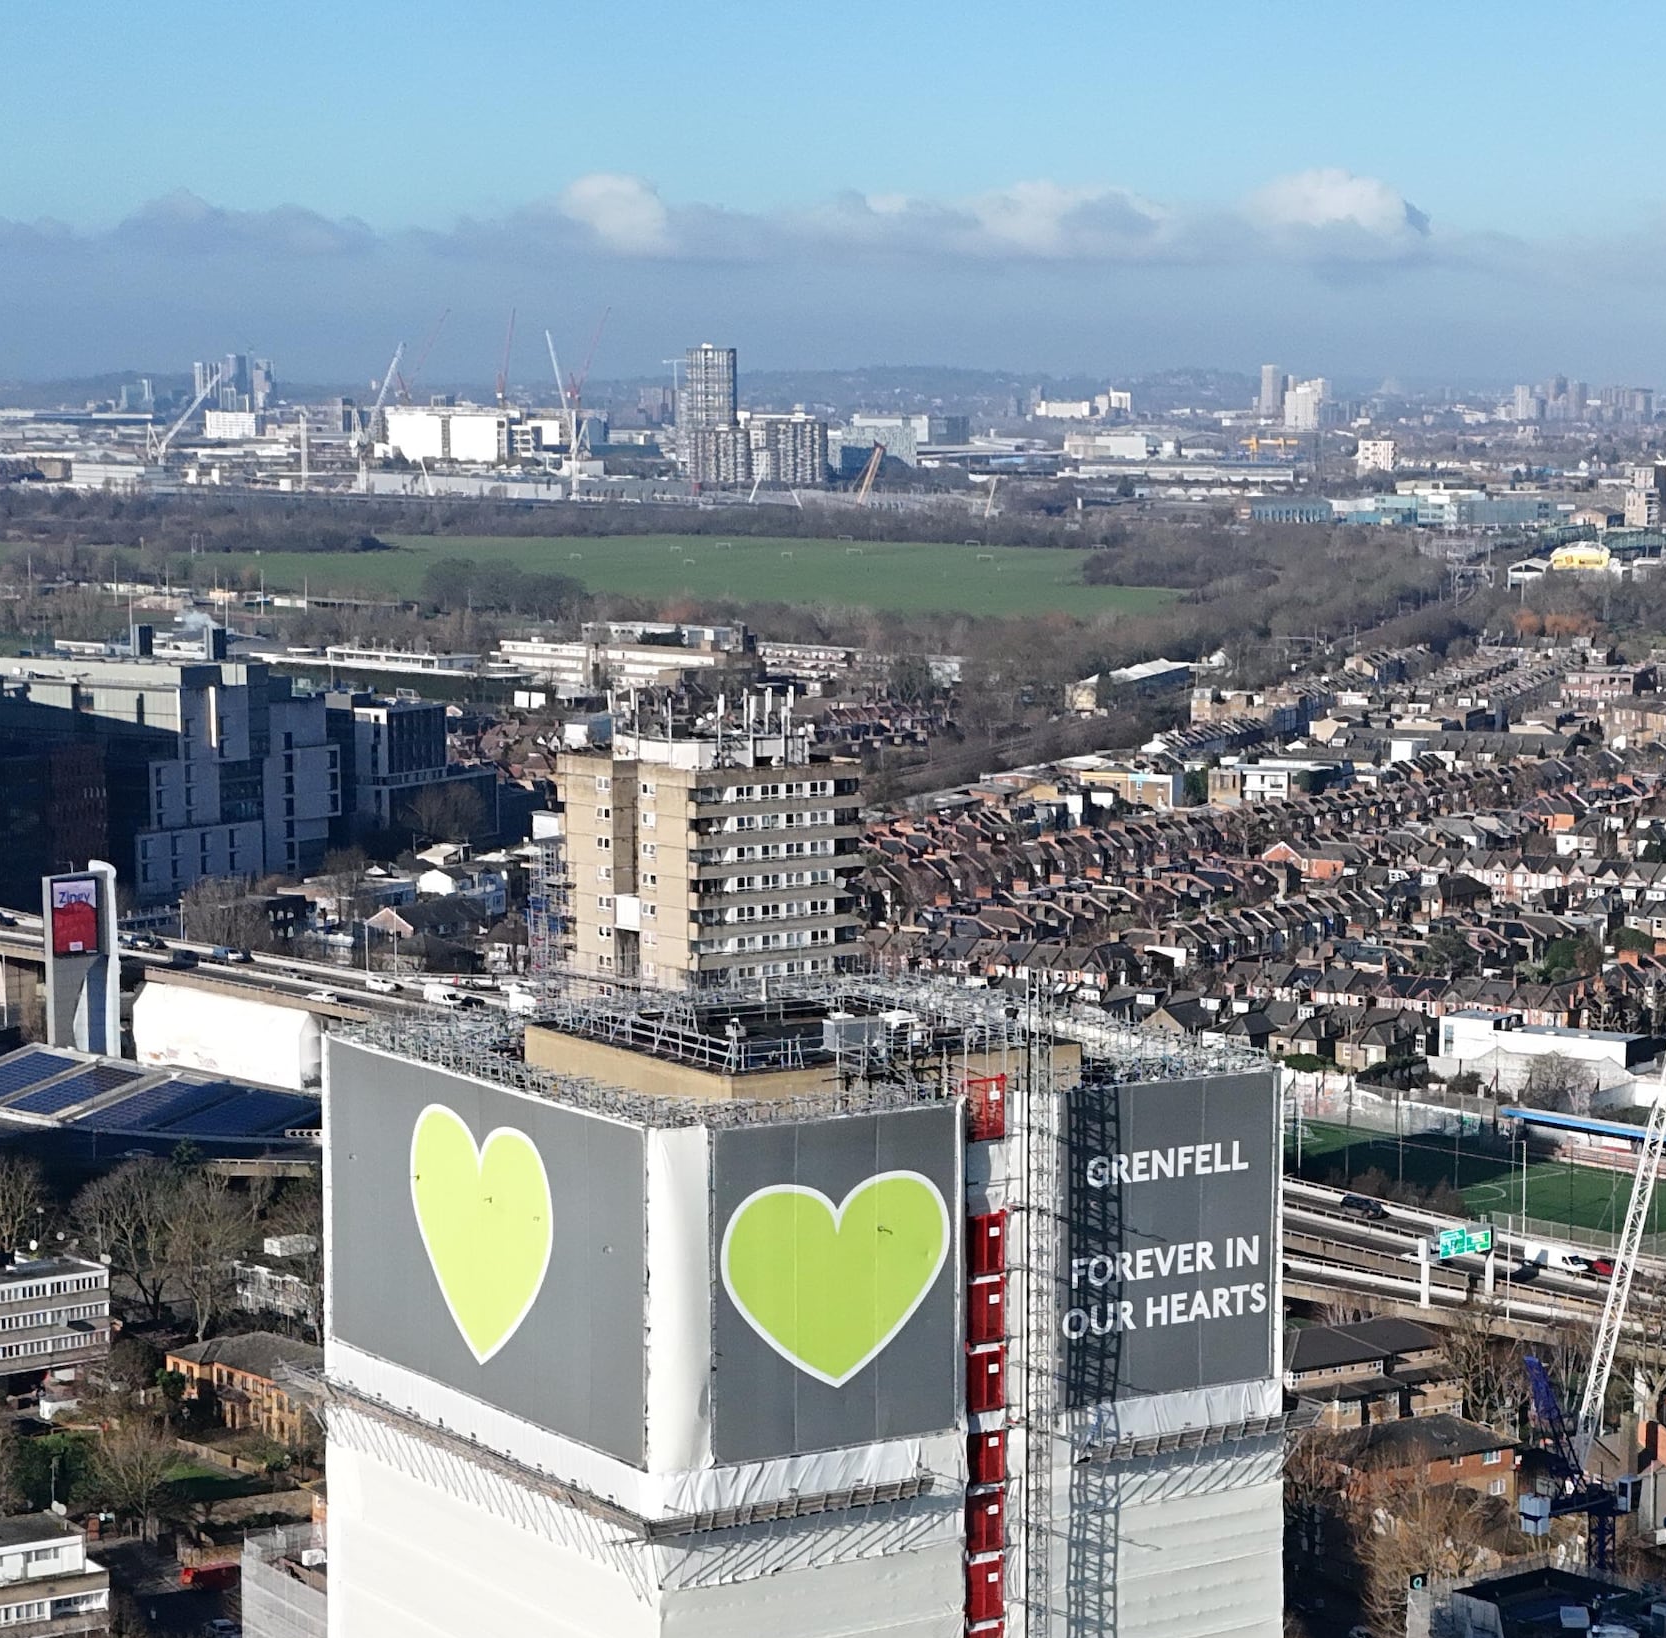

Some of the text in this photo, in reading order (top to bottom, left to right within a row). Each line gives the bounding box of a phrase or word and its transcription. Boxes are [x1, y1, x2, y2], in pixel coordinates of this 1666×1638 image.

[1086, 1140, 1250, 1189] GRENFELL
[1071, 1235, 1260, 1290] FOREVER IN
[1061, 1283, 1267, 1340] OUR HEARTS
